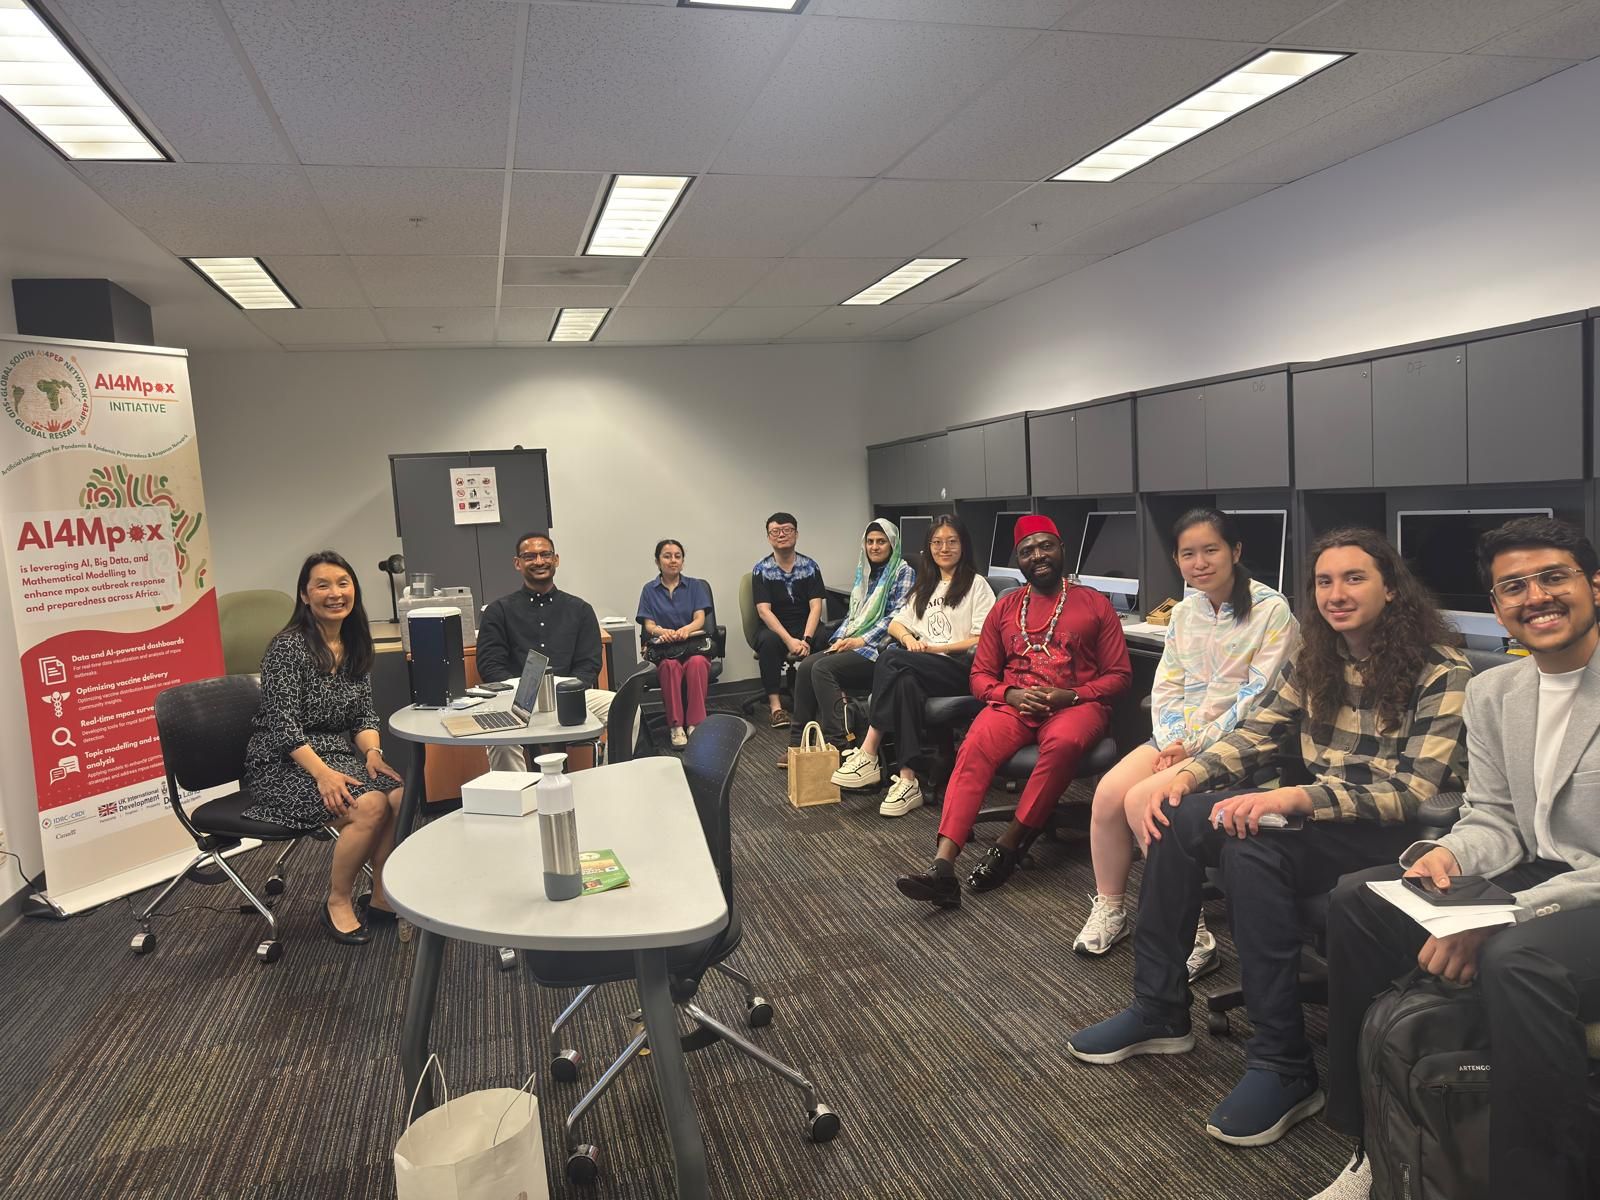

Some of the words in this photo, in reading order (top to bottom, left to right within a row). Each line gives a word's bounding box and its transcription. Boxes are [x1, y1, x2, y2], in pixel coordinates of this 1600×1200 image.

[1, 366, 13, 397] GLOBAL
[9, 350, 35, 367] SOUTH
[64, 361, 88, 398] NETWORK
[109, 401, 166, 413] INITIATIVE
[3, 402, 16, 418] SUD
[15, 418, 47, 439] GLOBAL
[1, 459, 22, 475] Artificial
[21, 448, 52, 463] Intelligence
[20, 564, 28, 573] is
[30, 561, 79, 572] leveraging
[81, 558, 93, 568] AI,
[94, 557, 108, 567] Big
[109, 556, 132, 565] Data,
[133, 553, 149, 563] and
[22, 572, 84, 586] Mathematical
[85, 568, 126, 580] Modelling
[24, 589, 63, 599] enhance
[65, 586, 90, 595] mpox
[92, 580, 129, 591] outbreak
[131, 578, 166, 588] response
[26, 602, 45, 613] and
[47, 597, 106, 612] preparedness
[107, 593, 134, 602] across
[135, 589, 161, 599] Africa.
[72, 654, 90, 662] Data
[91, 650, 105, 659] and
[106, 643, 146, 656] AI-powered
[147, 637, 185, 650] dashboards
[76, 681, 115, 695] Optimizing
[116, 676, 141, 687] vaccine
[142, 671, 169, 682] delivery
[81, 714, 115, 727] Real-time
[116, 710, 135, 719] mpox
[136, 705, 155, 714] surve
[84, 749, 103, 759] Topic
[104, 741, 138, 754] modelling
[139, 736, 152, 745] and
[86, 756, 115, 769] analysis
[119, 794, 160, 811] Development
[127, 788, 159, 802] International
